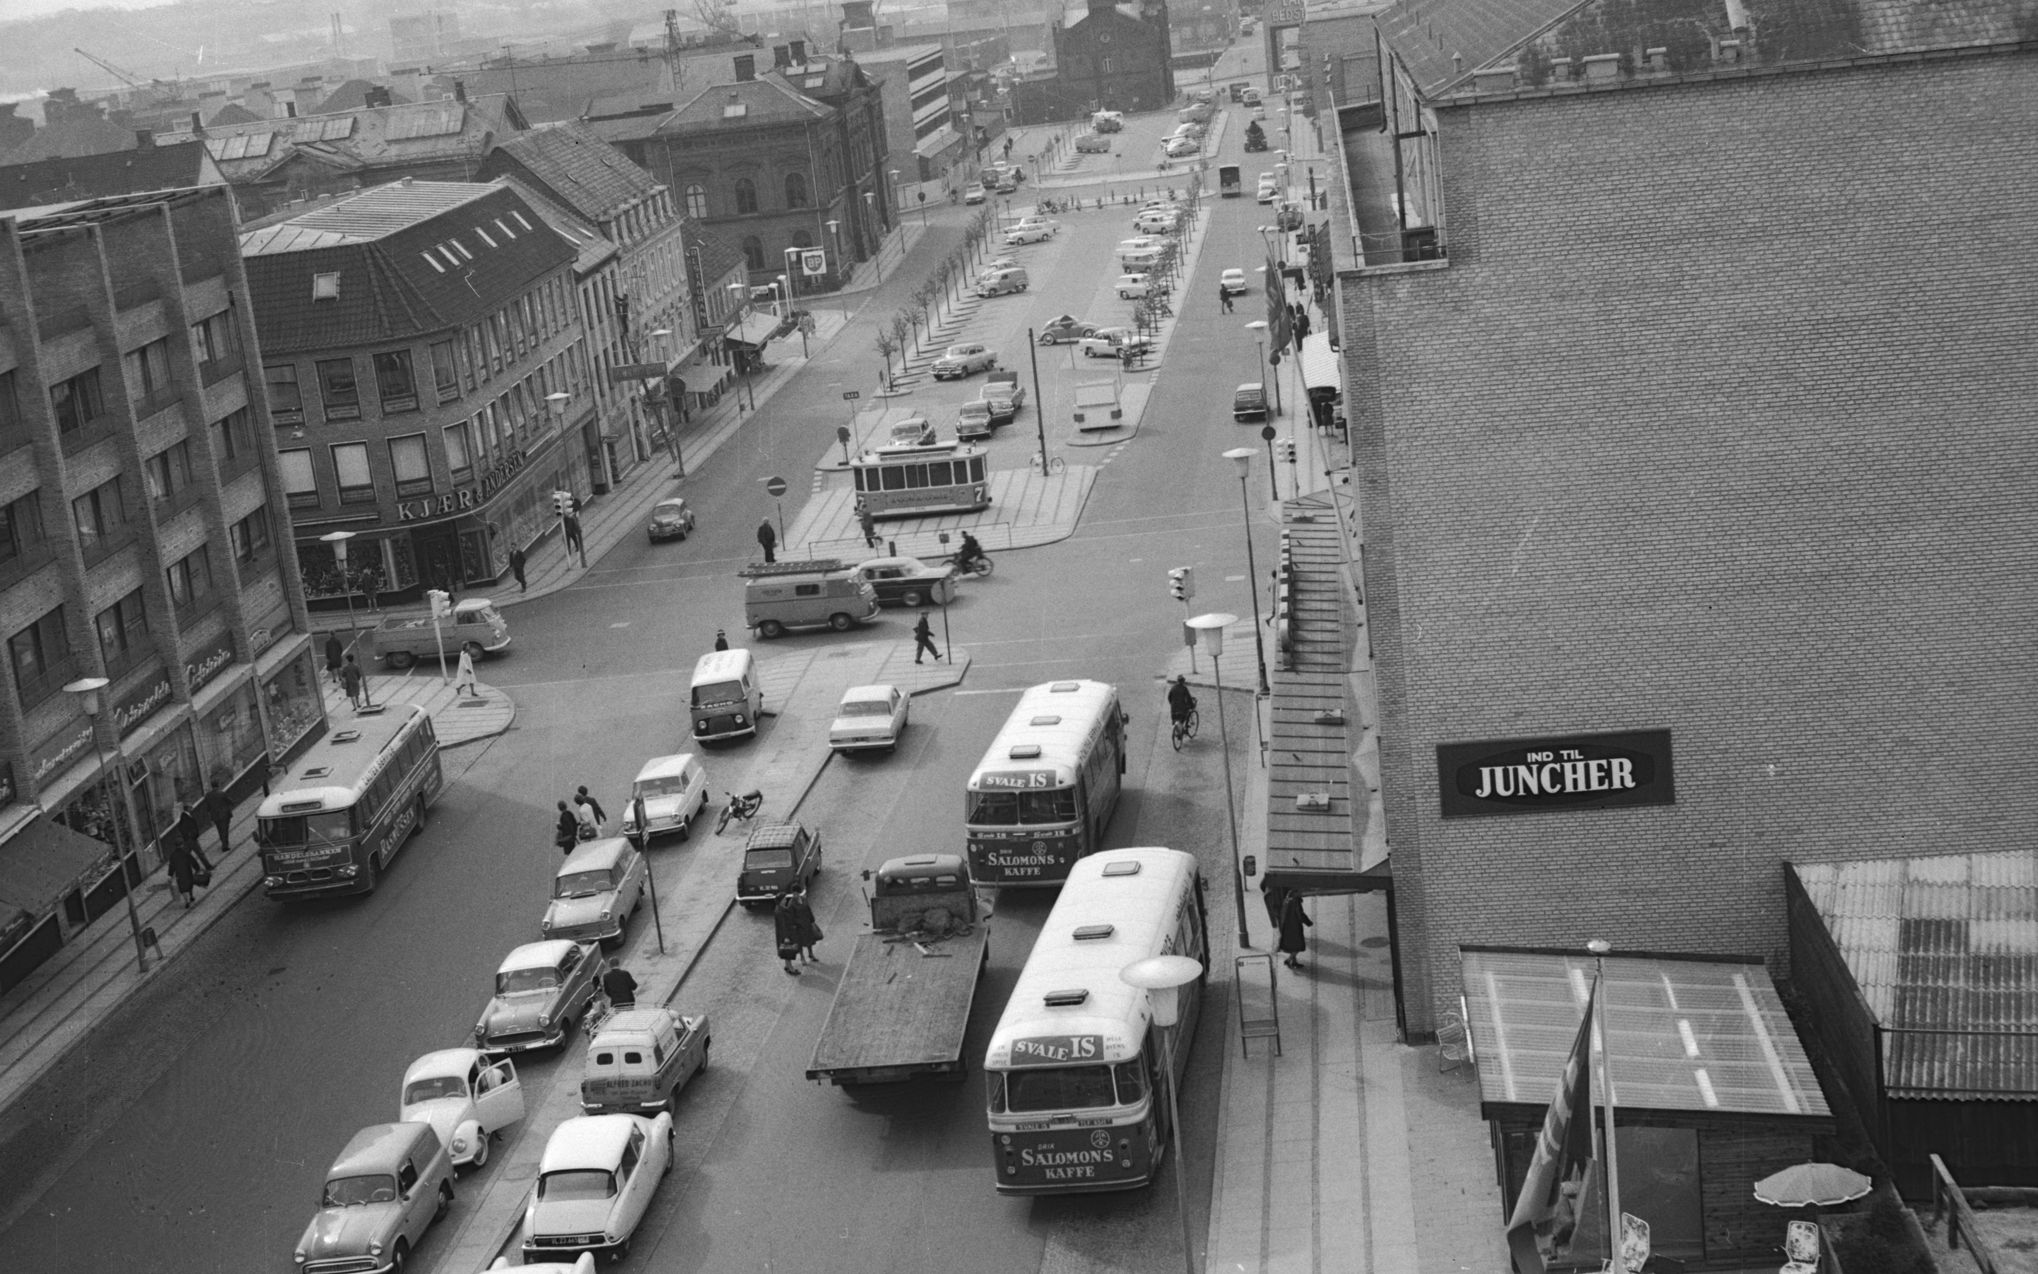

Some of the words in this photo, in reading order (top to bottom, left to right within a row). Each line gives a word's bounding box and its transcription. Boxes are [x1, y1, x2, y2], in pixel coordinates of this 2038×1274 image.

[807, 257, 821, 269] BP
[396, 489, 472, 520] KJÆR
[485, 450, 524, 497] ANDERSEN
[974, 487, 984, 502] 7
[1527, 751, 1553, 762] IND
[1560, 749, 1584, 760] TIL
[986, 775, 1025, 788] SVALE
[1028, 773, 1047, 788] IS
[1475, 757, 1636, 798] JUNCHER
[988, 852, 1055, 866] SALOMONS
[1004, 867, 1041, 876] KAFFE
[1015, 1040, 1069, 1061] SVALE
[1070, 1036, 1096, 1058] IS
[606, 1080, 630, 1088] ALFRED
[1021, 1149, 1114, 1167] SALOMONS
[1045, 1166, 1095, 1179] KAFFE
